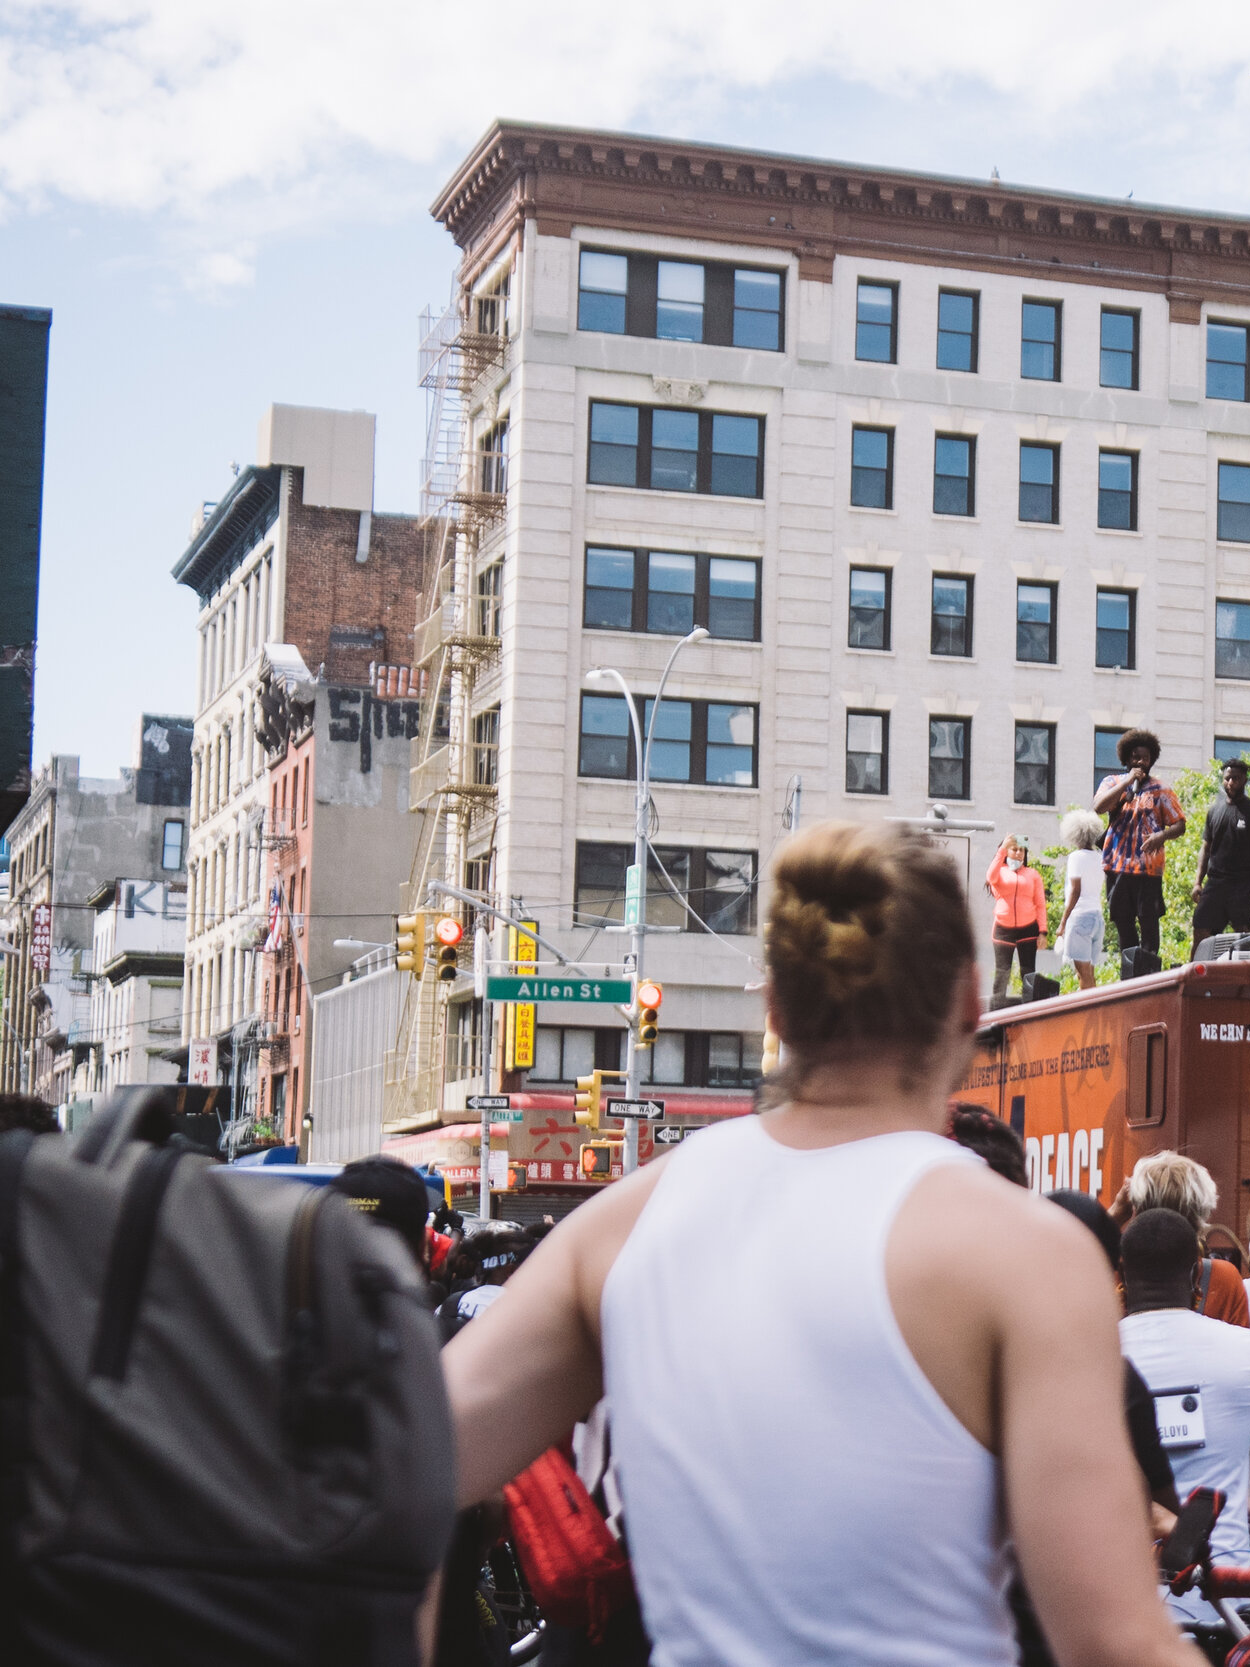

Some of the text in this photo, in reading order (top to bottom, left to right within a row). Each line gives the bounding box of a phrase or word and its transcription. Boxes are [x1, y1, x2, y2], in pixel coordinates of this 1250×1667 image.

[517, 982, 602, 998] Allen St
[1200, 1023, 1218, 1040] WE
[1219, 1024, 1244, 1041] CAN
[614, 1104, 656, 1113] ONE WAY
[491, 1111, 514, 1121] ALLEN
[662, 1130, 678, 1139] ONE
[1024, 1128, 1104, 1200] PEACE
[446, 1168, 474, 1178] ALLEN
